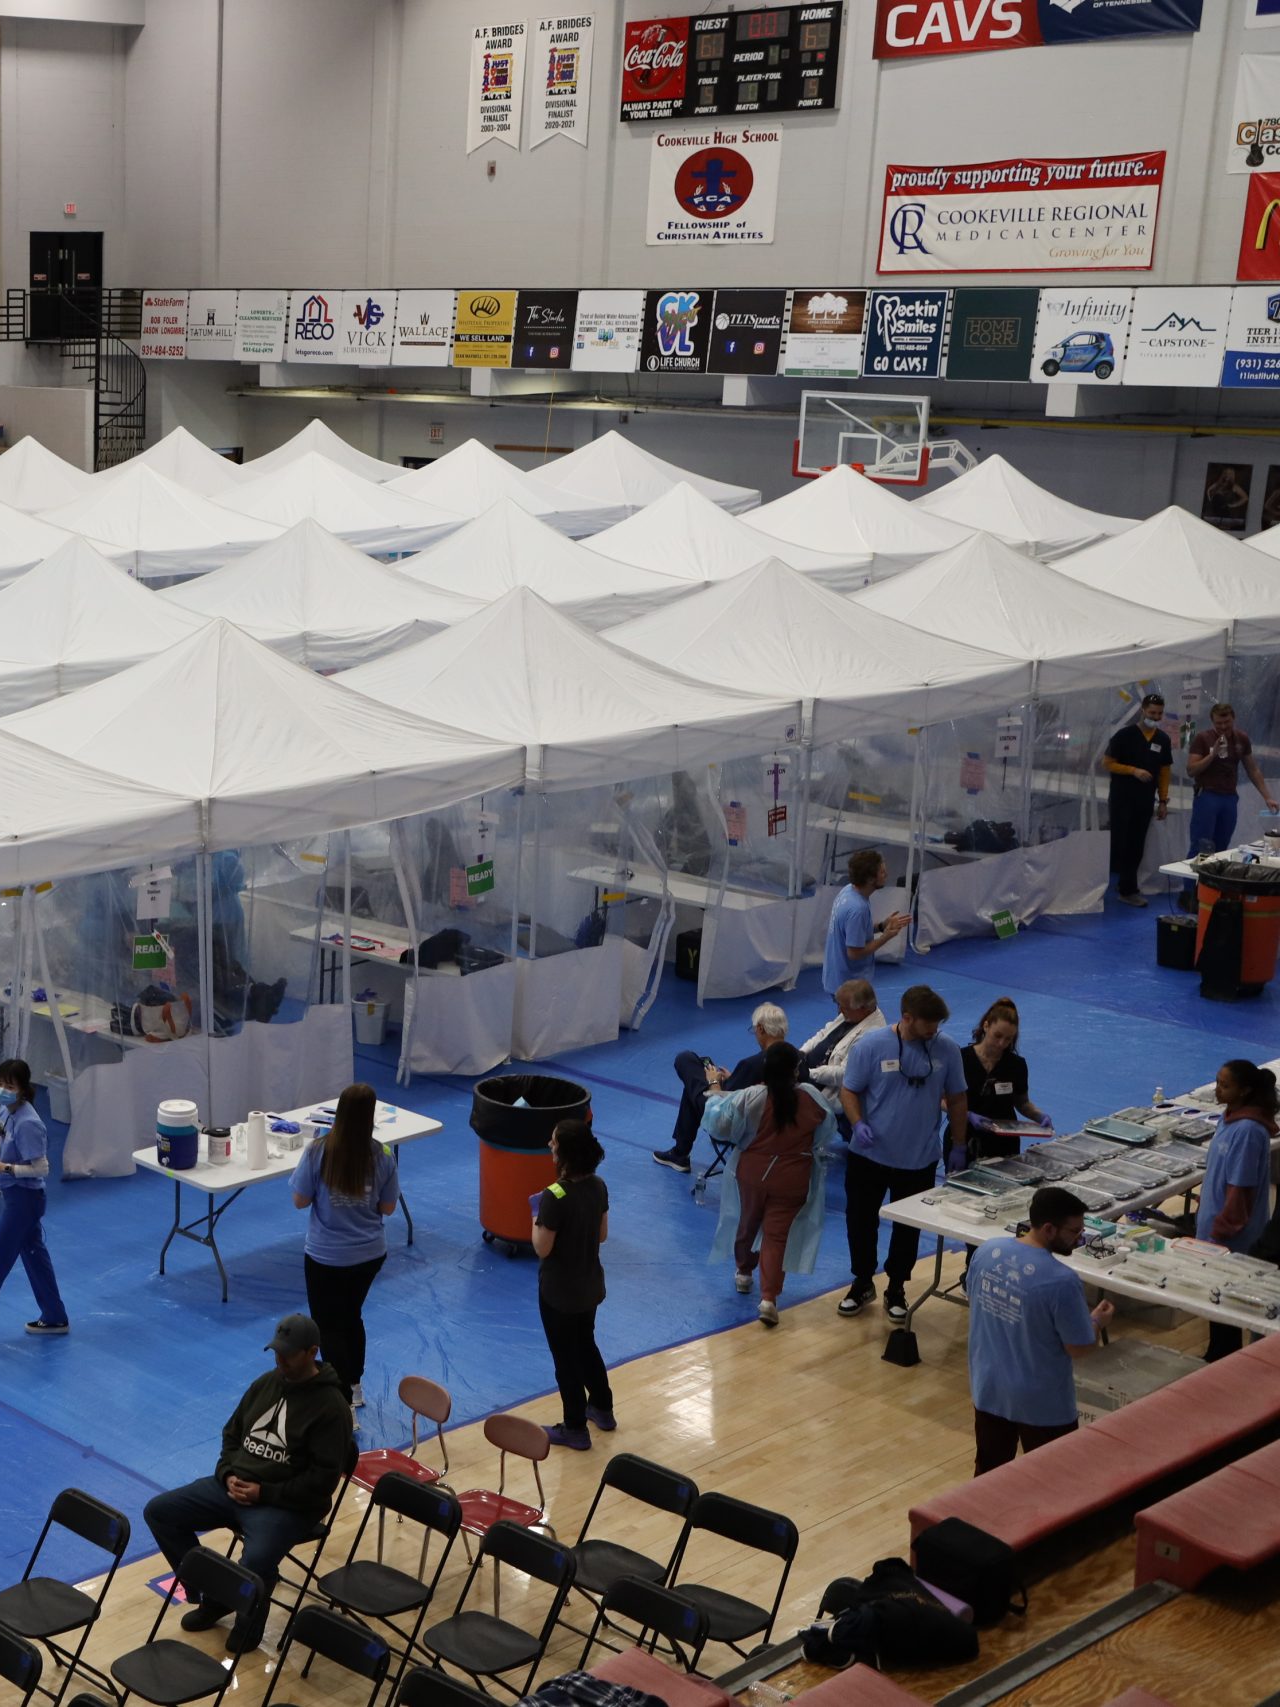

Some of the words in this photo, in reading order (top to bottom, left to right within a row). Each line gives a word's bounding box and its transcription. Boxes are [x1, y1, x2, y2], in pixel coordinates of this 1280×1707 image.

[800, 7, 833, 20] HOME
[540, 21, 554, 31] A.F.
[557, 17, 591, 29] BRIDGES
[695, 18, 729, 30] GUEST
[885, 0, 1022, 47] CAVS
[475, 28, 489, 38] A.F.
[492, 24, 524, 36] BRIDGES
[550, 32, 579, 44] AWARD
[485, 38, 512, 50] AWARD
[733, 52, 764, 62] PERIOD
[737, 72, 782, 82] PLAYER-FOUL
[802, 69, 823, 77] FOULS
[698, 77, 718, 85] FOULS
[545, 99, 577, 108] DIVISIONAL
[623, 102, 652, 111] ALWAYS
[652, 101, 673, 109] PART
[673, 100, 683, 108] OF
[735, 103, 759, 111] MATCH
[798, 98, 823, 107] POINTS
[480, 104, 512, 114] DIVISIONAL
[548, 110, 573, 119] FINALIST
[630, 110, 649, 119] YOUR
[650, 109, 673, 117] TEAM!
[695, 106, 717, 114] POINTS
[483, 114, 508, 123] FINALIST
[481, 124, 511, 132] 2003-2004
[545, 120, 575, 129] 2020-2021
[891, 167, 951, 191] proudly
[953, 163, 1041, 190] supporting
[1044, 163, 1085, 186] your
[693, 195, 731, 204] FCA
[937, 207, 1045, 225] COOKEVILLE
[1052, 203, 1148, 221] REGIONAL
[936, 229, 1039, 242] MEDICAL
[1051, 225, 1147, 238] CENTER
[1049, 246, 1100, 261] Growing
[1099, 244, 1121, 260] for
[1122, 244, 1145, 258] You
[526, 305, 542, 324] The
[1063, 297, 1127, 325] Infinity
[151, 316, 161, 324] BOB
[295, 323, 334, 340] RECO
[895, 319, 936, 333] Smiles
[970, 320, 1015, 332] HOME
[215, 328, 233, 337] HILL
[399, 327, 448, 338] WALLACE
[347, 331, 387, 346] VICK
[1149, 339, 1207, 348] CAPSTONE
[660, 357, 674, 366] LIFE
[675, 358, 700, 367] CHURCH
[874, 356, 889, 371] GO
[893, 356, 928, 373] CAVS!
[1235, 359, 1262, 370] (931)
[468, 868, 493, 883] READY
[243, 1436, 291, 1465] Reebok
